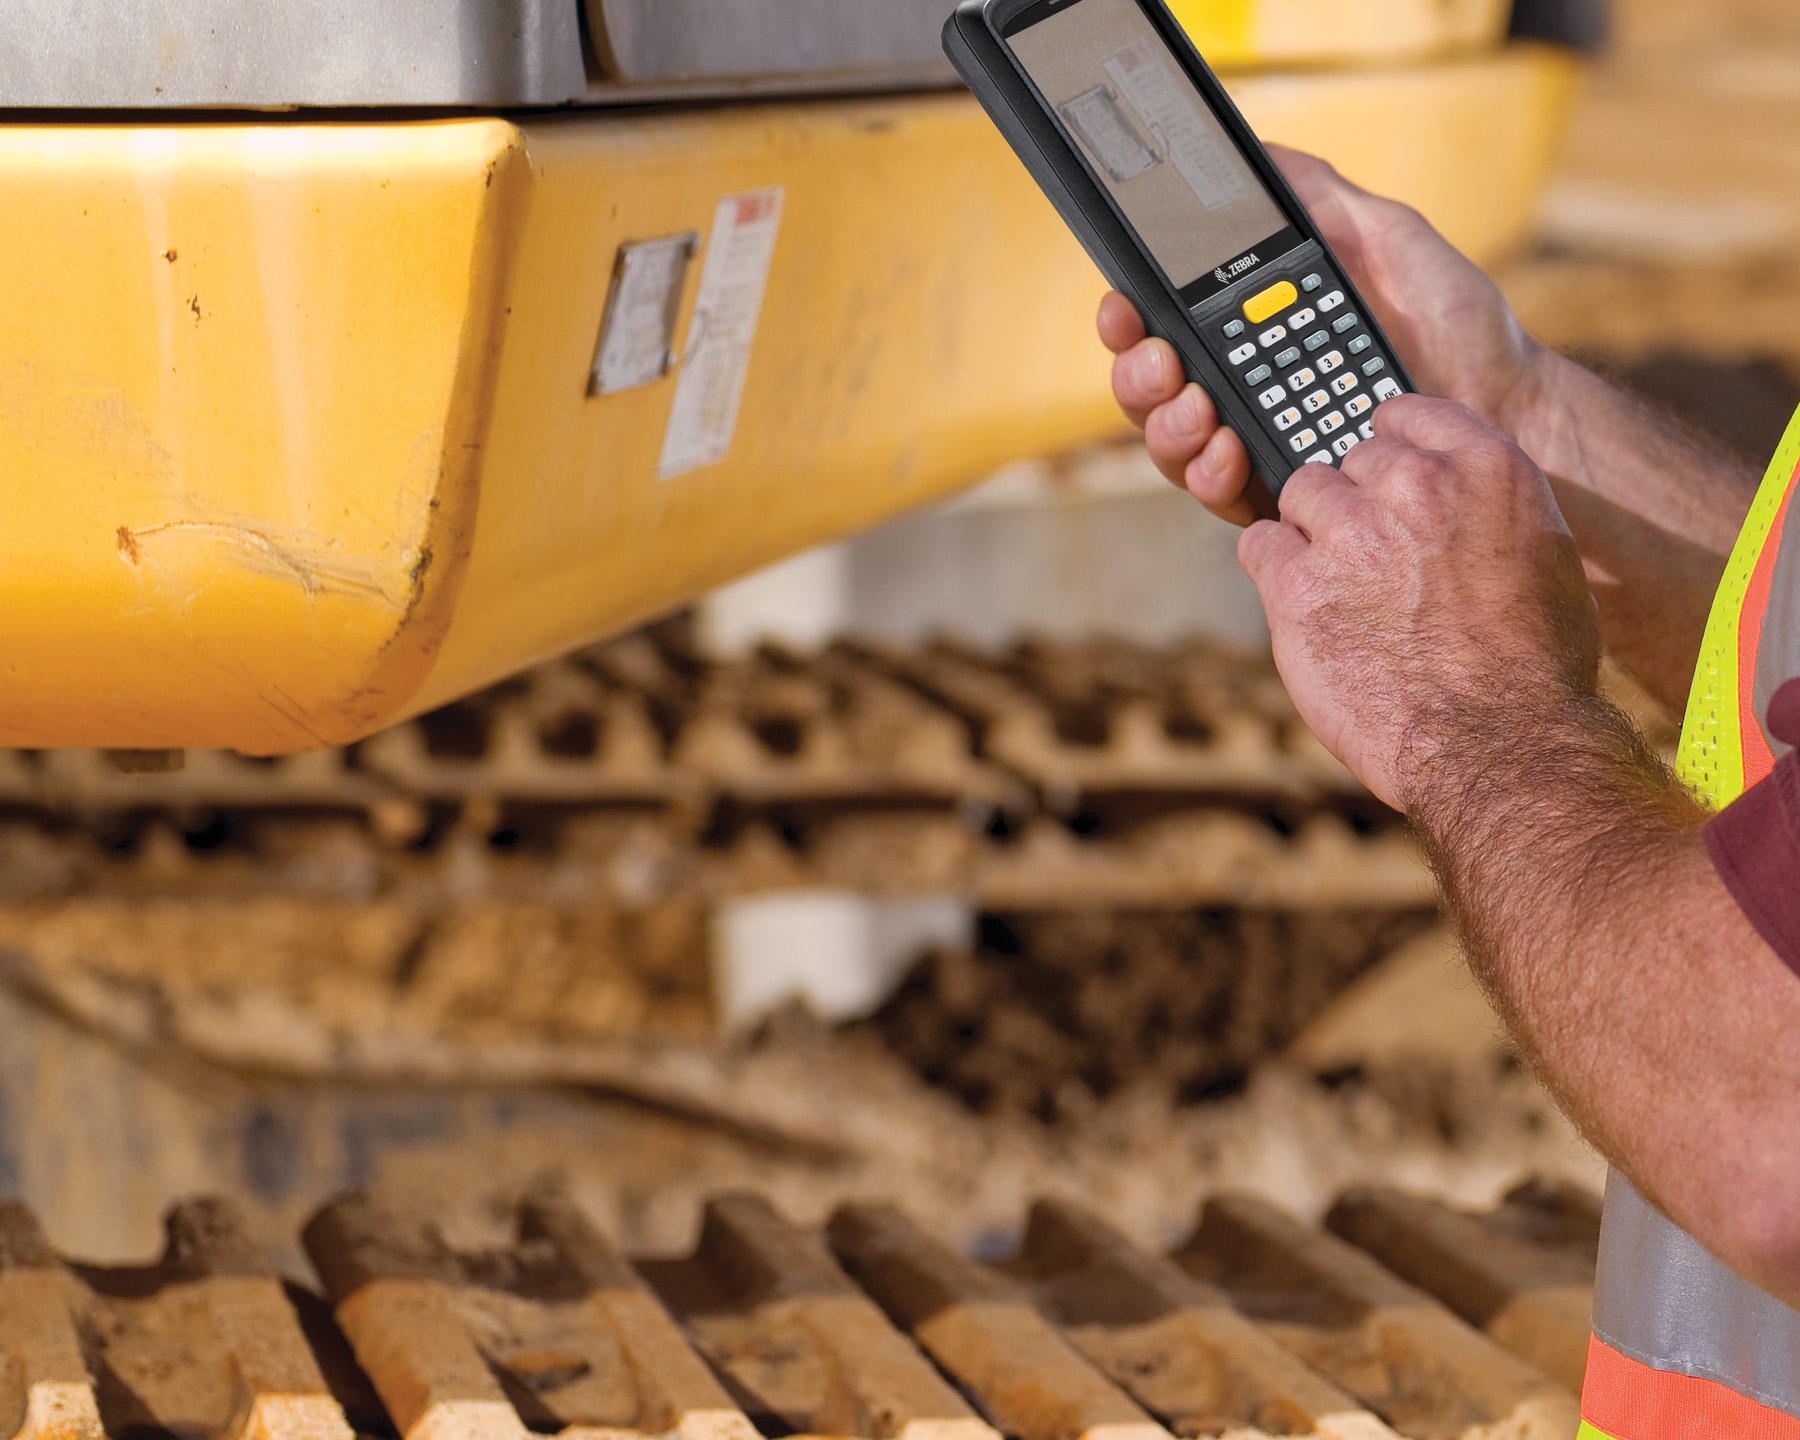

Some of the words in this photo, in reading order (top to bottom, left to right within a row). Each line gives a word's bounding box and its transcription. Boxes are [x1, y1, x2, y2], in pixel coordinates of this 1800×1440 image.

[1228, 253, 1260, 276] ZEBRA
[1307, 278, 1318, 287] P2
[1230, 324, 1240, 333] P1
[1312, 335, 1324, 346] ALT
[1281, 352, 1294, 362] TAB
[1253, 369, 1266, 380] ESC
[1265, 393, 1274, 404] 1
